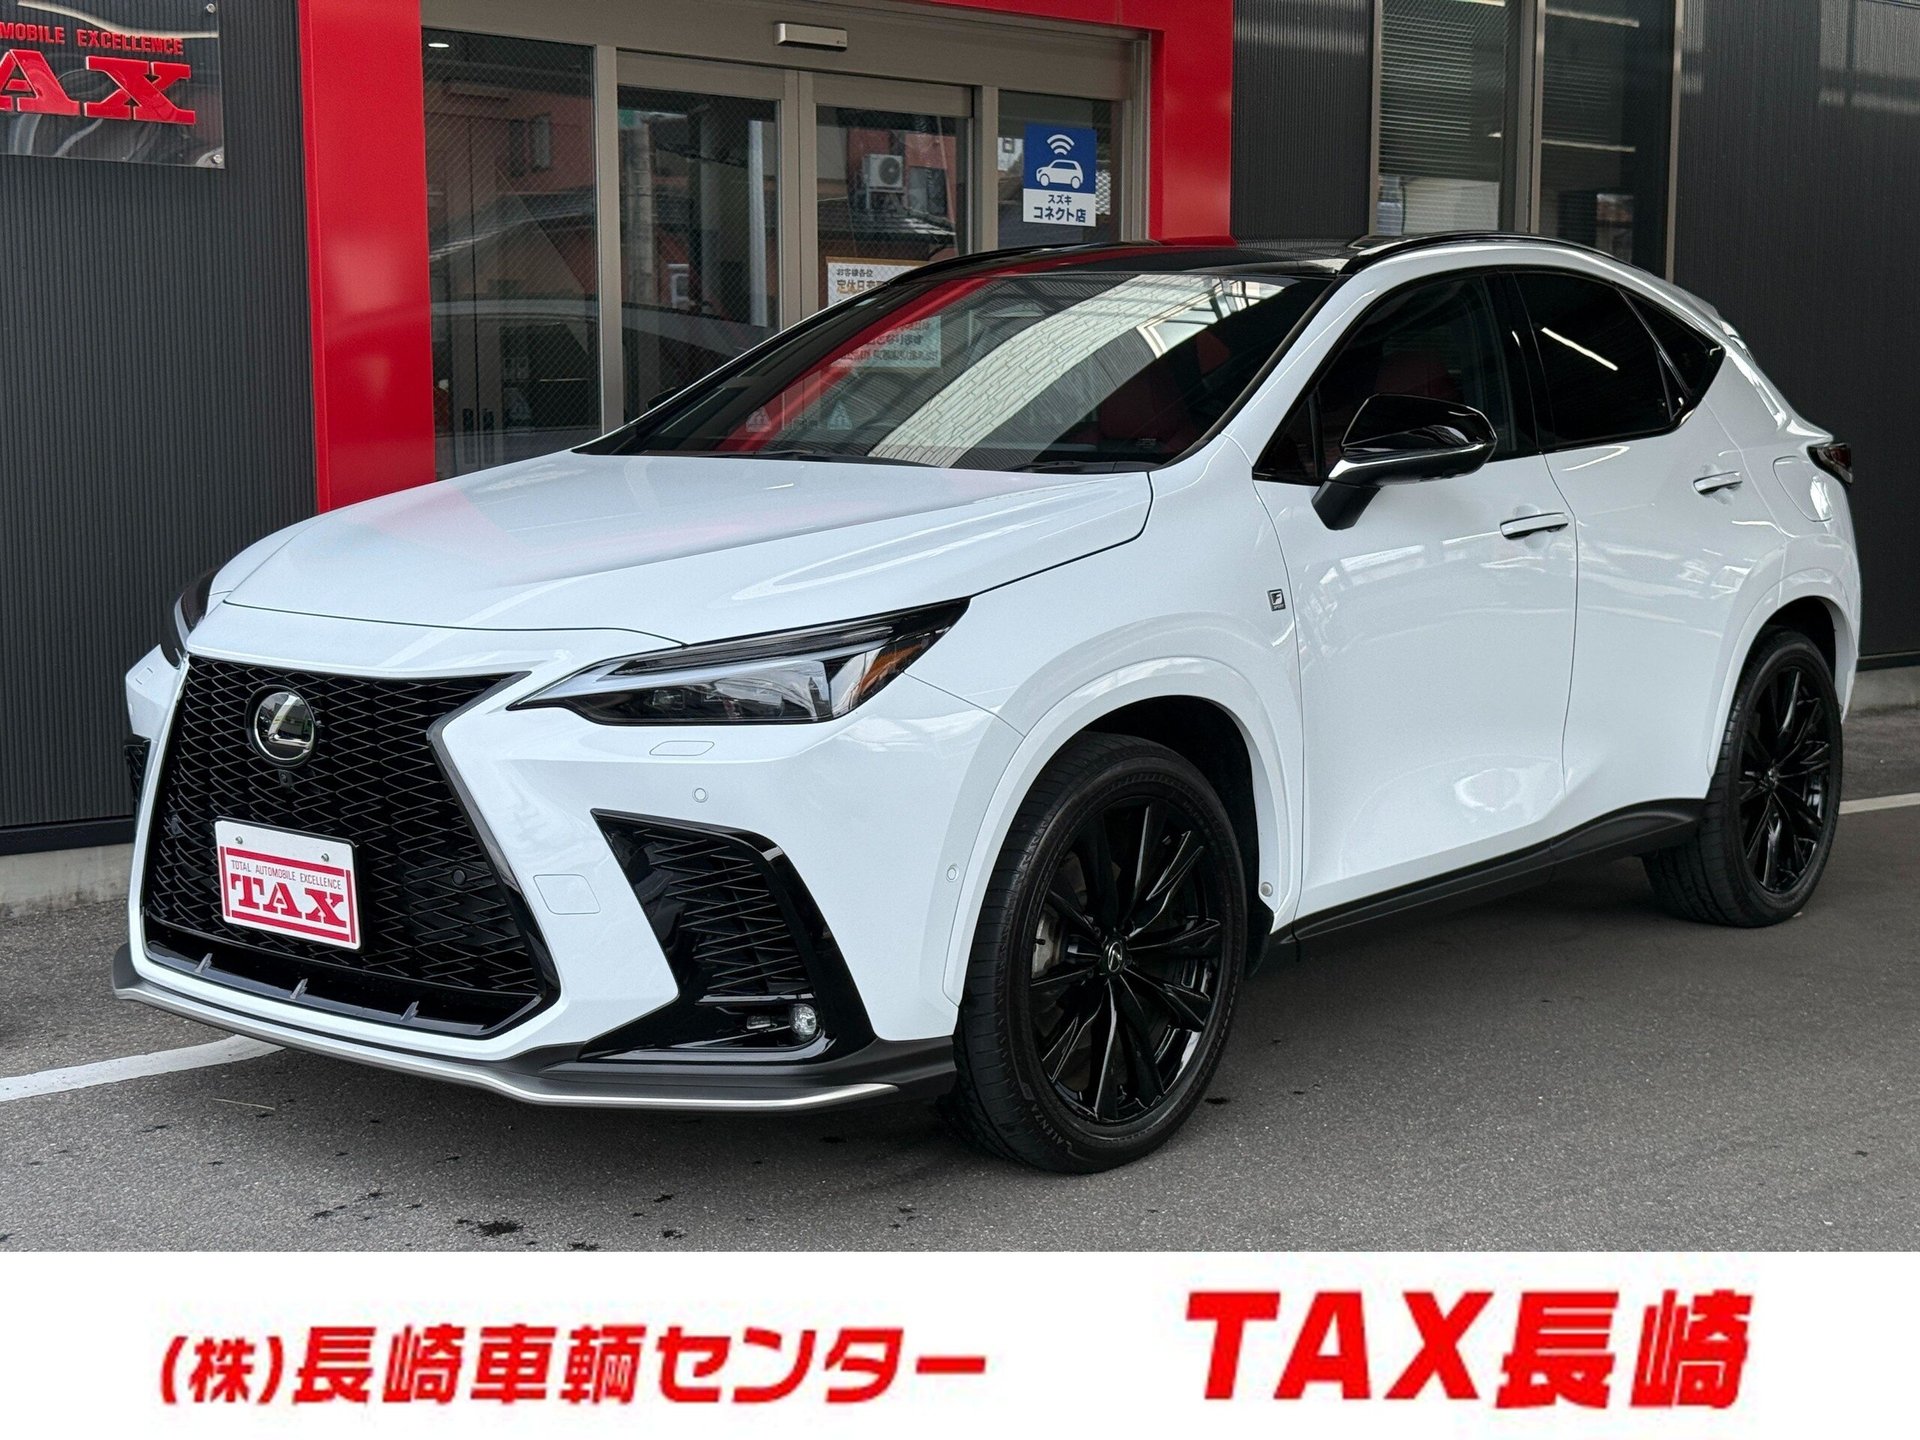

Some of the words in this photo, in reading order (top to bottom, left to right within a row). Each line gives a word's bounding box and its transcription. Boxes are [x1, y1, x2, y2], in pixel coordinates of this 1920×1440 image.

[76, 29, 184, 55] EXCELLENCE
[1048, 194, 1072, 205] スズキ
[1033, 206, 1086, 223] コネクト店
[231, 859, 252, 873] TOTAL
[255, 864, 297, 881] AUTOMOBILE
[300, 872, 342, 890] EXCELLENCE
[230, 873, 347, 928] TAX
